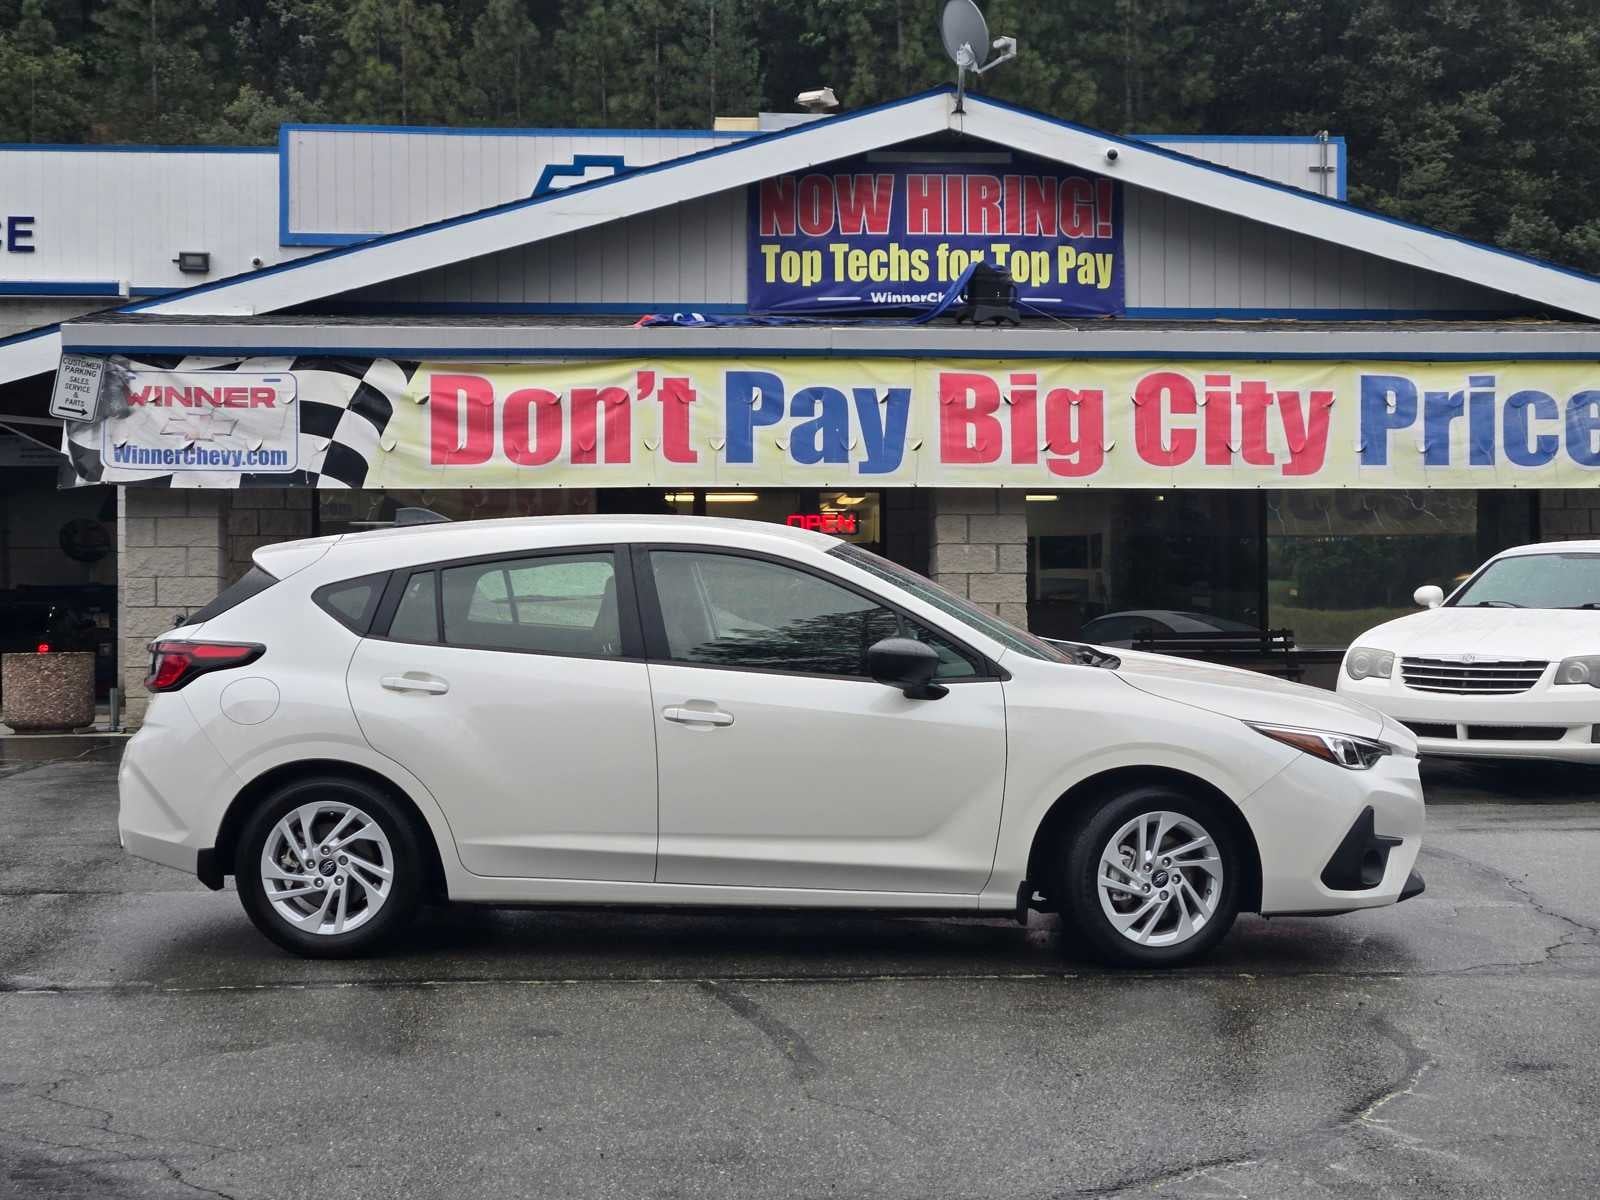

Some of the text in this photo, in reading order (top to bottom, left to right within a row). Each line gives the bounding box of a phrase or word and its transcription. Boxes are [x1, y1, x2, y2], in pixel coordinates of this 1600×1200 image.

[759, 173, 1113, 239] NOW HIRING!
[0, 216, 35, 253] E
[761, 244, 823, 287] Top
[829, 242, 930, 283] Techs
[990, 243, 1050, 287] Top
[1058, 245, 1114, 290] Pay
[65, 365, 97, 378] PARKING
[69, 375, 89, 386] SALES
[65, 382, 90, 393] SERVICE
[123, 385, 277, 409] WINNER
[65, 397, 85, 408] PARTS
[430, 370, 1600, 478] Don't Pay Big City Price
[113, 443, 288, 466] WinnerChevy.com
[786, 512, 856, 534] OPEN
